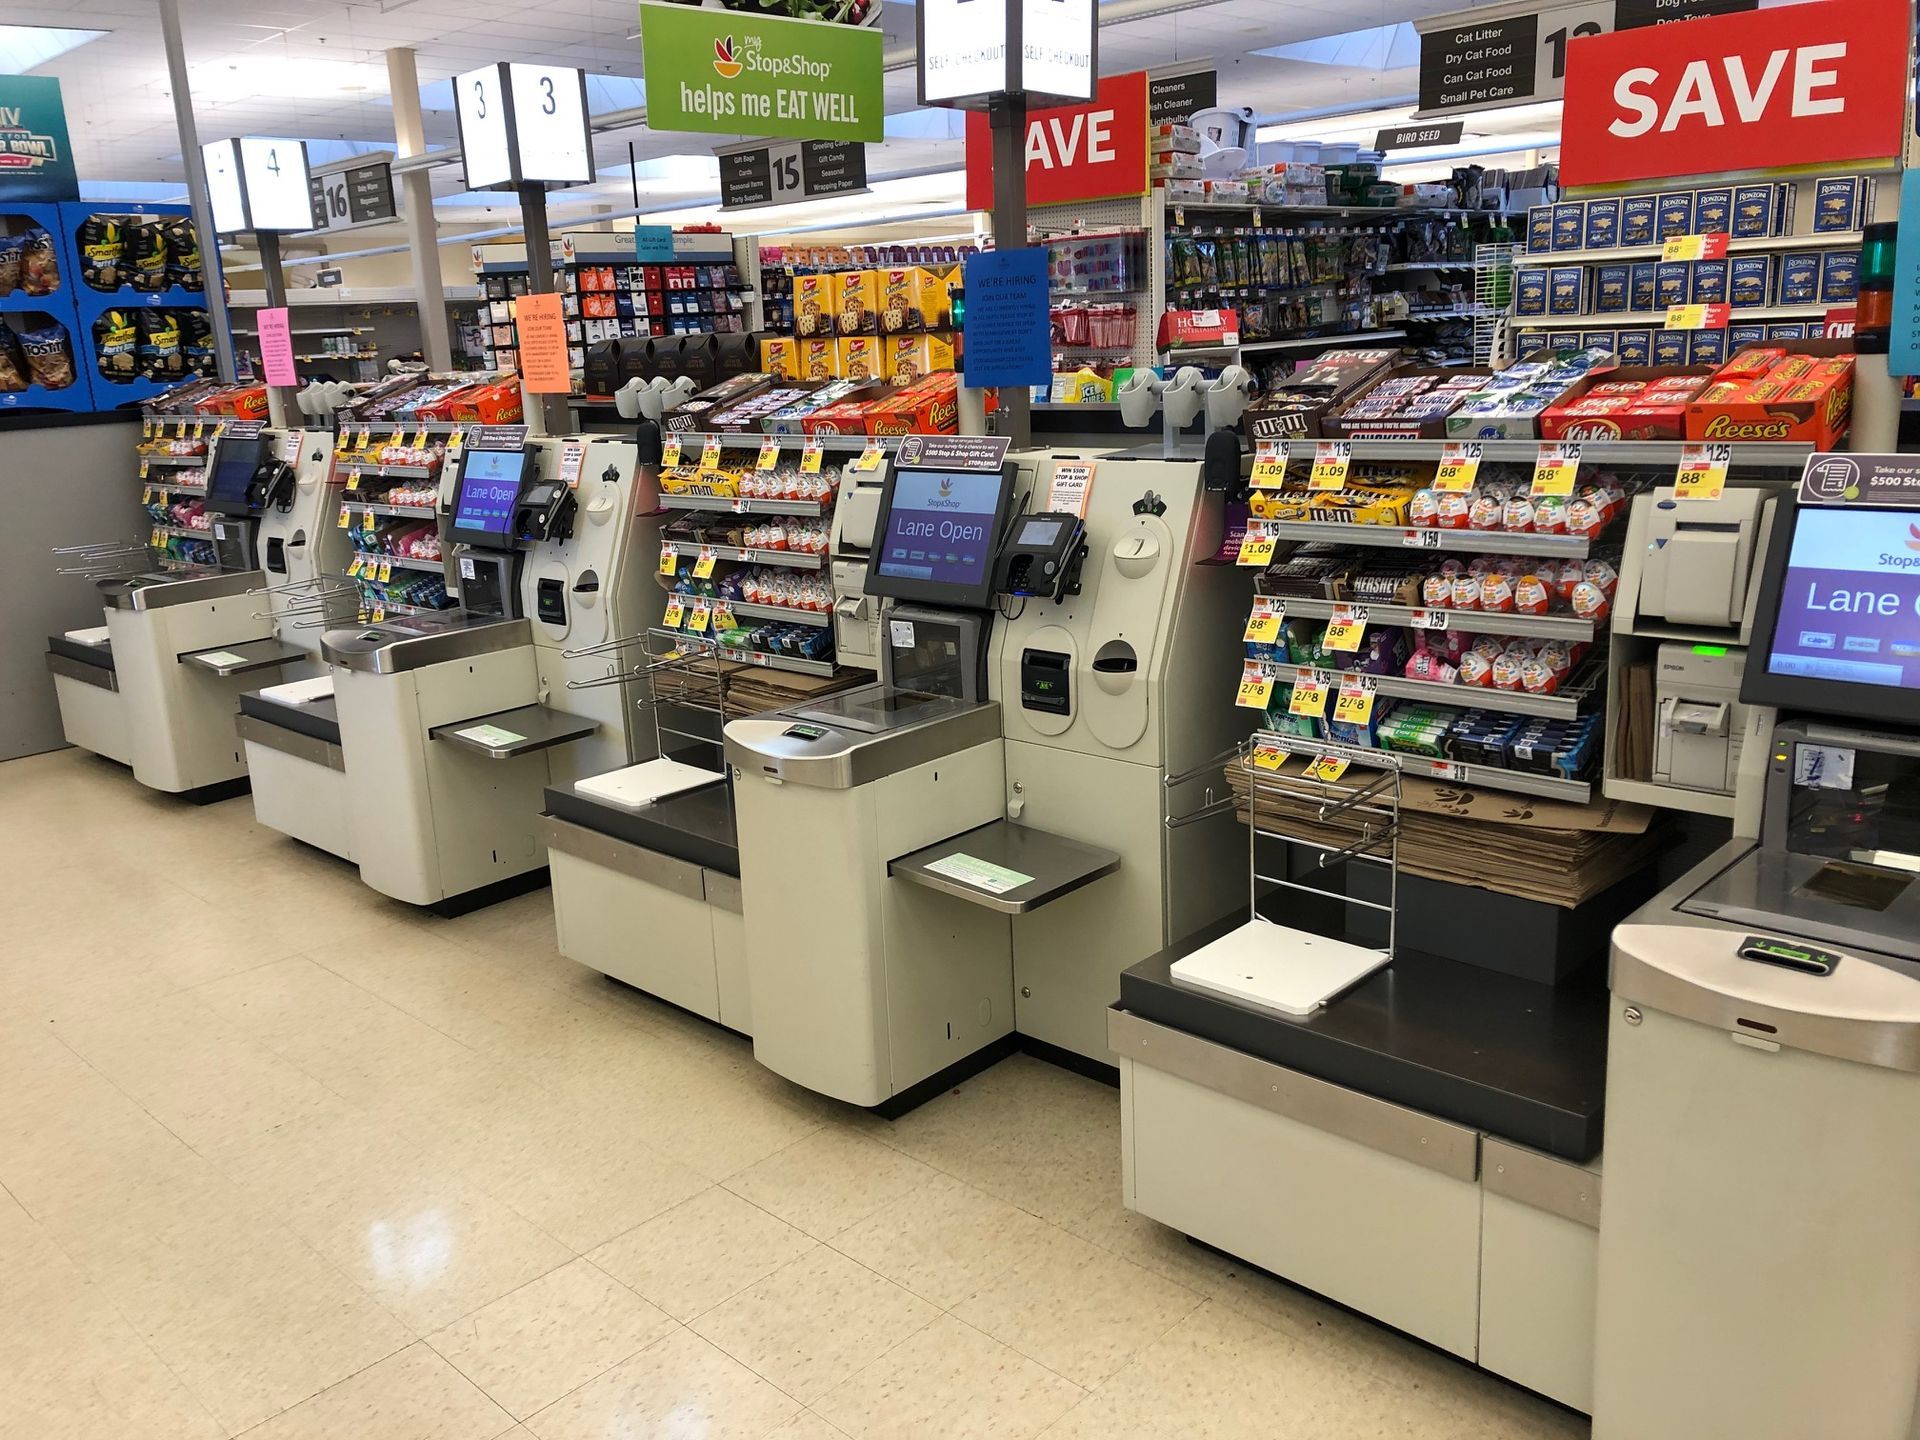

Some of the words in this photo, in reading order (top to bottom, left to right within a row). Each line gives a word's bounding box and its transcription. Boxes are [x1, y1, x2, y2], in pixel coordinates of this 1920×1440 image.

[744, 35, 762, 51] my
[1455, 33, 1472, 44] Cat
[1475, 28, 1502, 41] Litter
[1446, 53, 1463, 65] Dry
[1466, 50, 1482, 62] Cat
[1485, 44, 1512, 59] Food
[746, 50, 832, 82] Stop&Shop
[1443, 73, 1464, 84] Can
[1466, 70, 1483, 82] Cat
[1485, 66, 1512, 79] Food
[1152, 82, 1186, 94] Cleaners
[1440, 90, 1468, 104] Small
[1470, 88, 1486, 102] Pet
[1488, 85, 1514, 98] Care
[1607, 41, 1848, 139] SAVE
[474, 80, 486, 120] 3
[540, 76, 556, 115] 3
[680, 81, 736, 120] helps
[741, 92, 770, 118] me
[776, 88, 808, 120] EAT
[812, 92, 859, 123] WELL
[1149, 99, 1162, 111] ish
[1164, 97, 1193, 110] Cleaner
[1150, 113, 1188, 128] Lightbulbs
[1396, 132, 1417, 144] BIRD
[1418, 130, 1440, 142] SEED
[10, 140, 50, 156] BOWL
[812, 142, 834, 151] Greeting
[267, 148, 281, 177] 4
[734, 156, 742, 164] Gift
[743, 155, 755, 163] Bags
[828, 154, 845, 163] Candy
[772, 154, 800, 190] 15
[822, 168, 844, 177] Seasonal
[730, 183, 750, 191] Seasonal
[814, 182, 836, 192] Wrapping
[838, 180, 853, 188] Paper
[1821, 185, 1850, 194] RONZONI
[326, 184, 347, 218] 16
[1662, 199, 1688, 208] RONZONI
[1700, 195, 1727, 204] RONZONI
[1739, 192, 1766, 201] RONZONI
[1591, 205, 1615, 214] RONZONI
[1626, 202, 1651, 211] RONZONI
[1697, 264, 1724, 273] RONZONI
[1736, 262, 1763, 272] RONZONI
[1788, 258, 1816, 267] RONZONI
[1660, 266, 1685, 275] RONZONI
[978, 278, 1004, 288] WE'RE
[1006, 274, 1036, 286] HIRING
[1622, 335, 1646, 344] RONZONI
[1658, 333, 1683, 342] RONZONI
[1694, 331, 1720, 341] RONZONI
[1733, 331, 1759, 340] RONZONI
[1772, 329, 1798, 338] RONZONI
[875, 420, 909, 435] Reese's
[1566, 426, 1590, 440] Kit
[1590, 426, 1616, 440] Kat
[1704, 414, 1791, 438] Reese's
[1274, 442, 1290, 456] $1.19
[1334, 442, 1350, 456] $1.19
[1462, 444, 1482, 458] $1.25
[1560, 443, 1581, 459] $1.25
[1706, 444, 1730, 462] $1.25
[1256, 464, 1282, 476] $1.09
[1315, 466, 1344, 477] $1.09
[1870, 476, 1901, 486] $500
[466, 485, 487, 499] Lane
[490, 486, 514, 504] Open
[897, 518, 933, 536] Lane
[940, 520, 982, 543] Open
[1245, 544, 1272, 554] $1.09
[1354, 576, 1408, 593] HERSHEY'S
[1806, 583, 1900, 616] Lane
[1242, 684, 1264, 695] 2/$8
[1295, 691, 1318, 703] 2/$8
[1340, 698, 1364, 710] 2/$8
